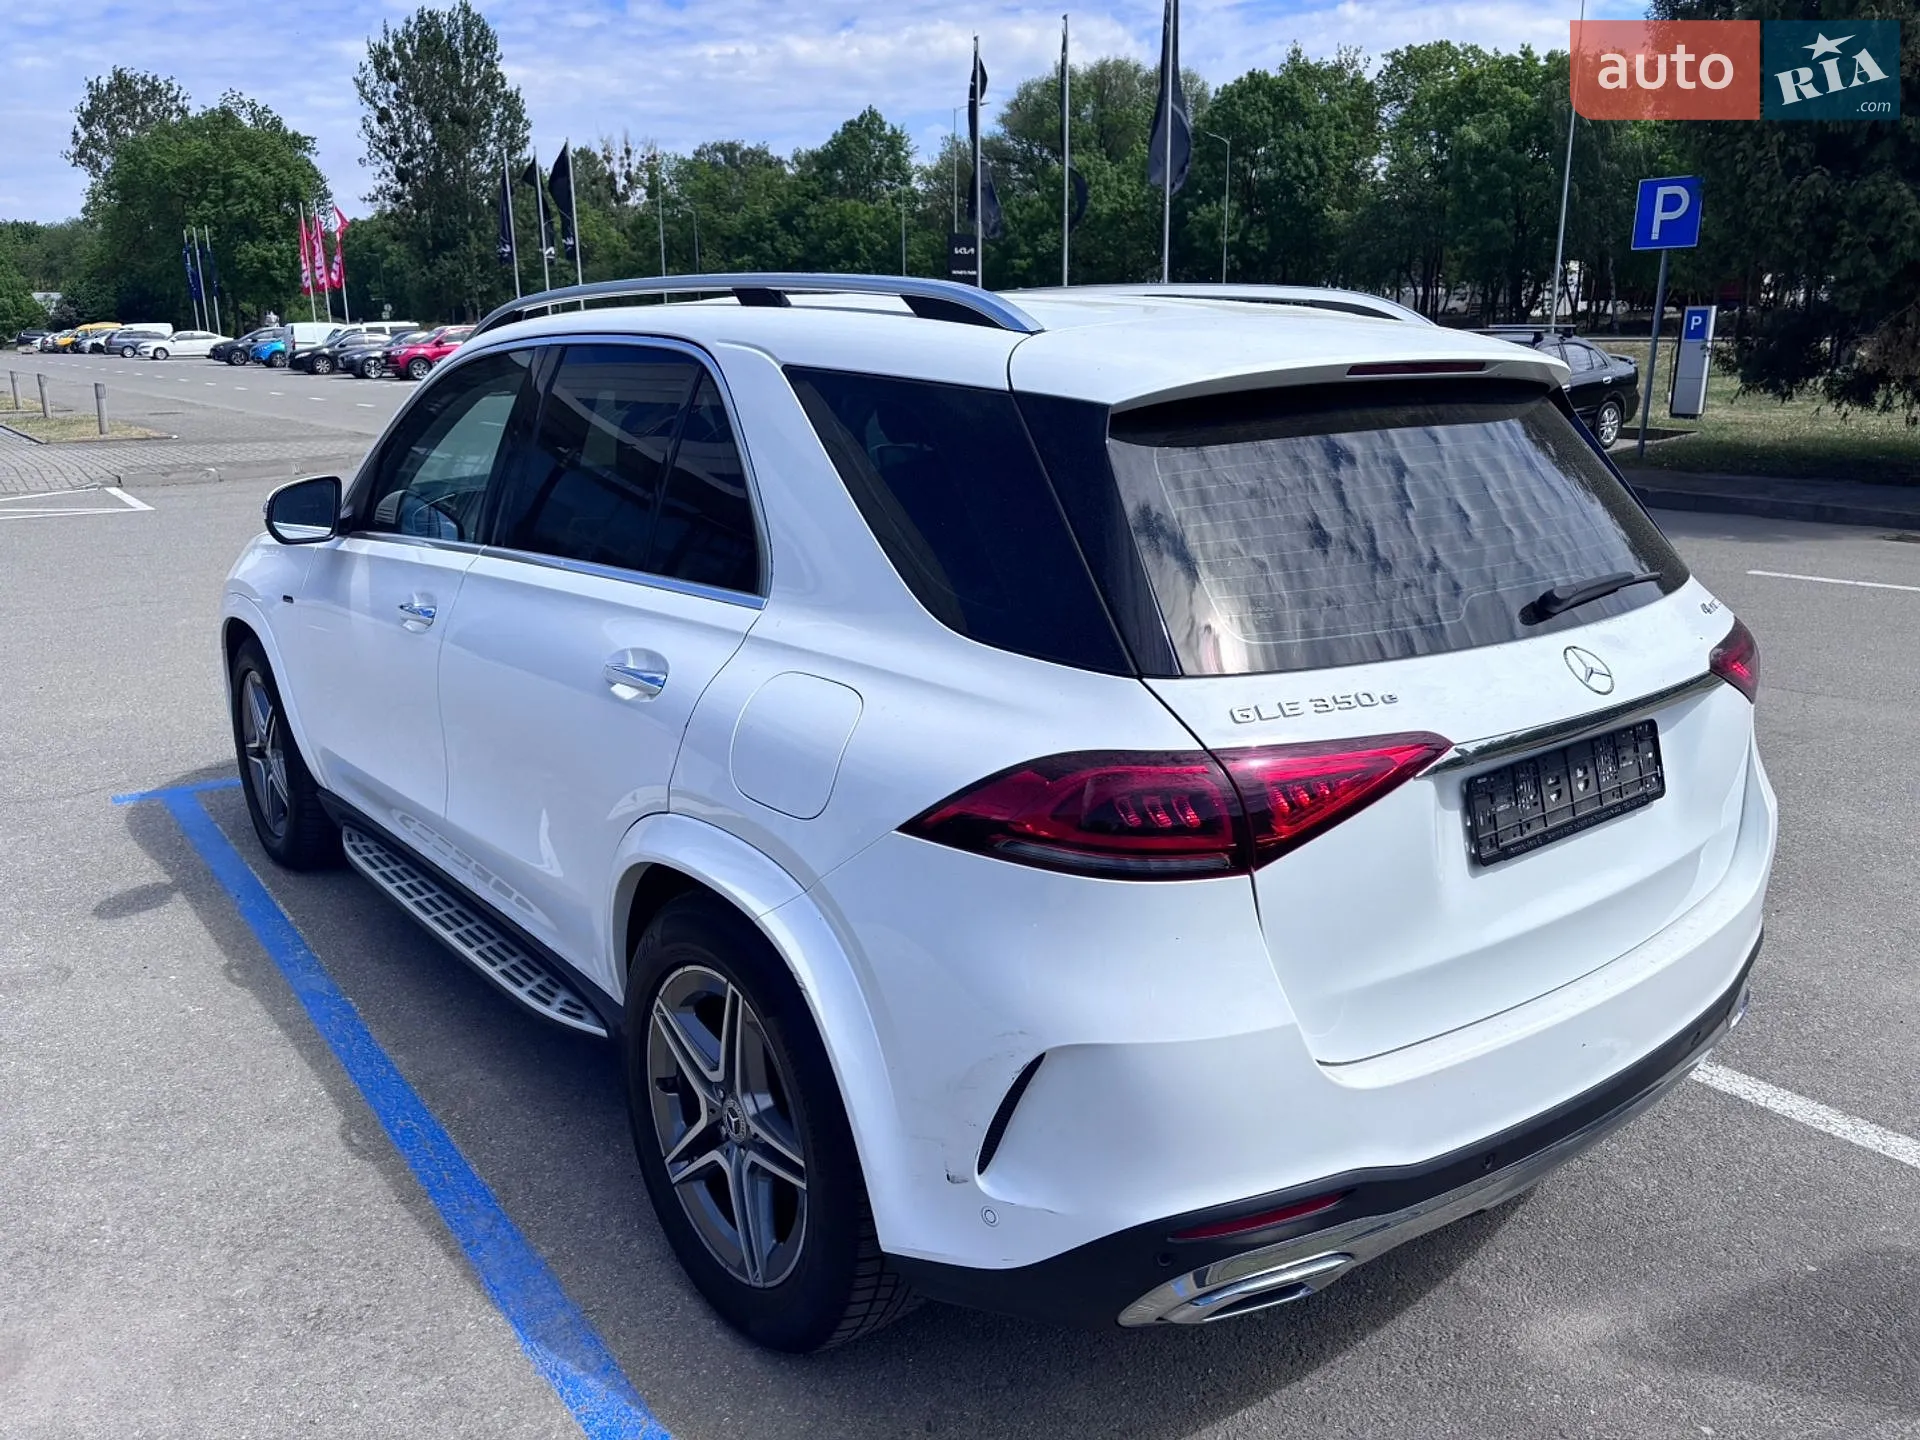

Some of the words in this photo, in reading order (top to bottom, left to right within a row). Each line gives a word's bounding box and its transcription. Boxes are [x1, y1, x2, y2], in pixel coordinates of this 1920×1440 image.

[1651, 185, 1690, 240] P
[1690, 315, 1703, 331] P
[1229, 701, 1305, 725] GLE
